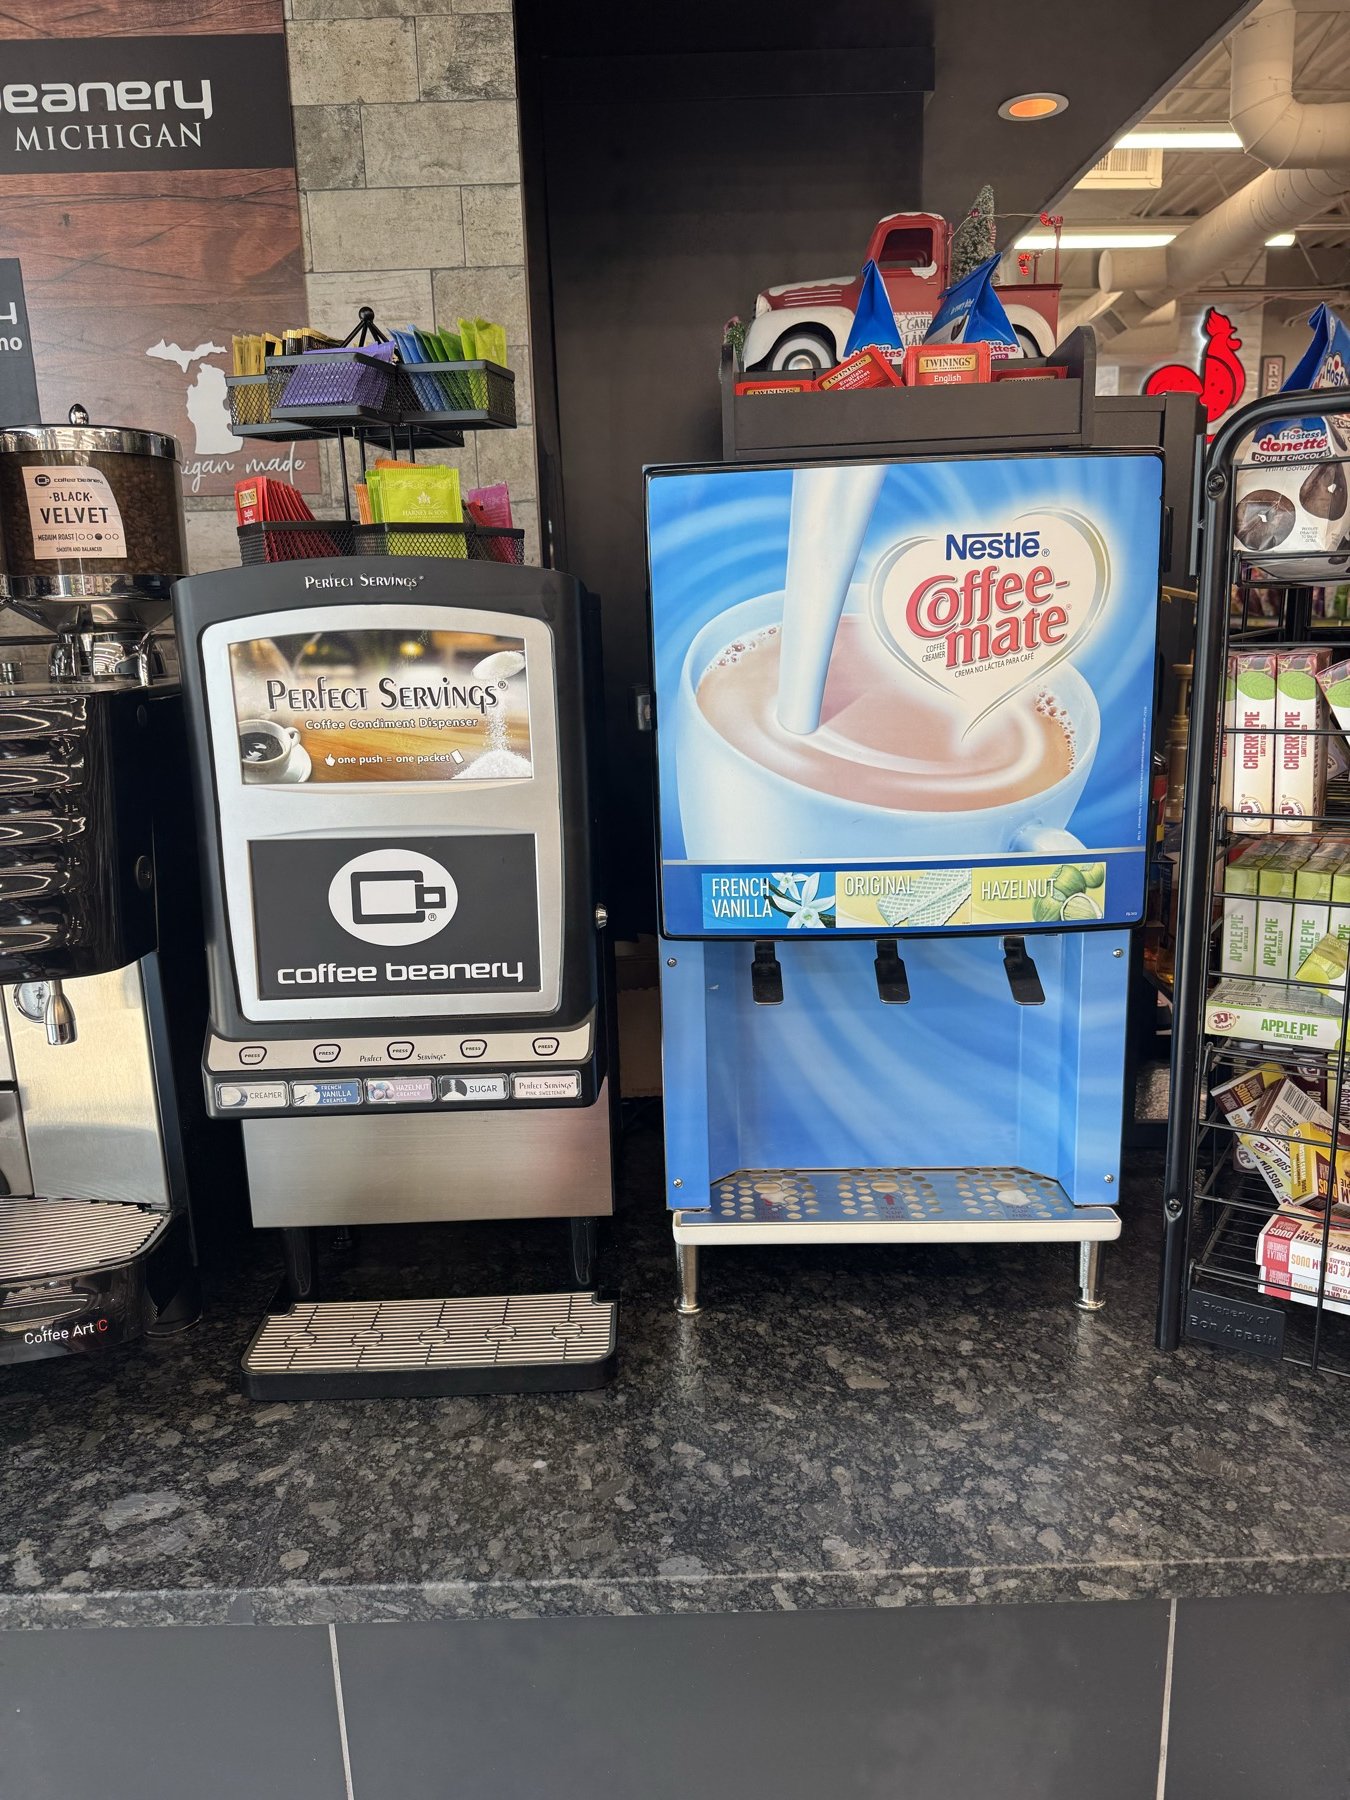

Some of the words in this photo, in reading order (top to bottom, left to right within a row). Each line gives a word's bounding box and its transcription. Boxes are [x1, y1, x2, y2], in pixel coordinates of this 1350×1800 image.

[0, 79, 213, 119] eanery
[15, 122, 202, 152] MICHIGAN
[827, 358, 868, 385] TWININGS
[924, 358, 972, 368] TWININGS
[838, 369, 865, 386] English
[934, 374, 962, 384] English
[1281, 430, 1320, 441] Hostess
[245, 442, 306, 485] made
[1254, 453, 1286, 462] DOUBLE
[40, 507, 109, 525] VELVET
[58, 532, 75, 541] ROAST
[945, 605, 1067, 669] mate
[925, 641, 946, 654] COFFEE
[921, 651, 946, 663] CREAMER
[954, 667, 975, 679] CREMA
[974, 665, 985, 674] NO
[1005, 656, 1021, 667] PARA
[305, 719, 345, 730] Coffee
[350, 717, 416, 730] Condiment
[419, 717, 478, 729] Dispenser
[1244, 711, 1260, 728] PIE
[1284, 711, 1301, 728] PIE
[337, 755, 357, 765] one
[359, 753, 383, 766] push
[396, 755, 415, 764] one
[417, 752, 451, 765] packet
[1243, 733, 1259, 769] CHERR
[1283, 734, 1300, 770] CHERR
[711, 877, 770, 897] FRENCH
[844, 875, 915, 896] ORIGINAL
[981, 878, 1057, 901] HAZELNUT
[711, 898, 773, 918] VANILLA
[1230, 914, 1244, 930] PIE
[1264, 917, 1279, 934] PIE
[1301, 919, 1316, 936] PIE
[1337, 923, 1350, 941] PIE
[1230, 931, 1244, 962] APPLE
[1263, 935, 1278, 967] APPLE
[1298, 936, 1315, 966] PPLE
[277, 963, 377, 984] coffee
[386, 961, 523, 983] beanery
[1261, 1018, 1298, 1035] APPLE
[1299, 1022, 1318, 1037] PIE
[249, 1091, 282, 1100] CREAMER
[322, 1089, 352, 1098] VANILLA
[395, 1083, 430, 1091] HAZELNUT
[469, 1084, 498, 1093] SUGAR
[1260, 1160, 1284, 1189] BOSTON
[1268, 1227, 1293, 1239] DUOS
[1291, 1253, 1311, 1268] DUOS
[24, 1329, 69, 1345] Coffee
[72, 1322, 95, 1337] Art
[97, 1319, 108, 1331] C
